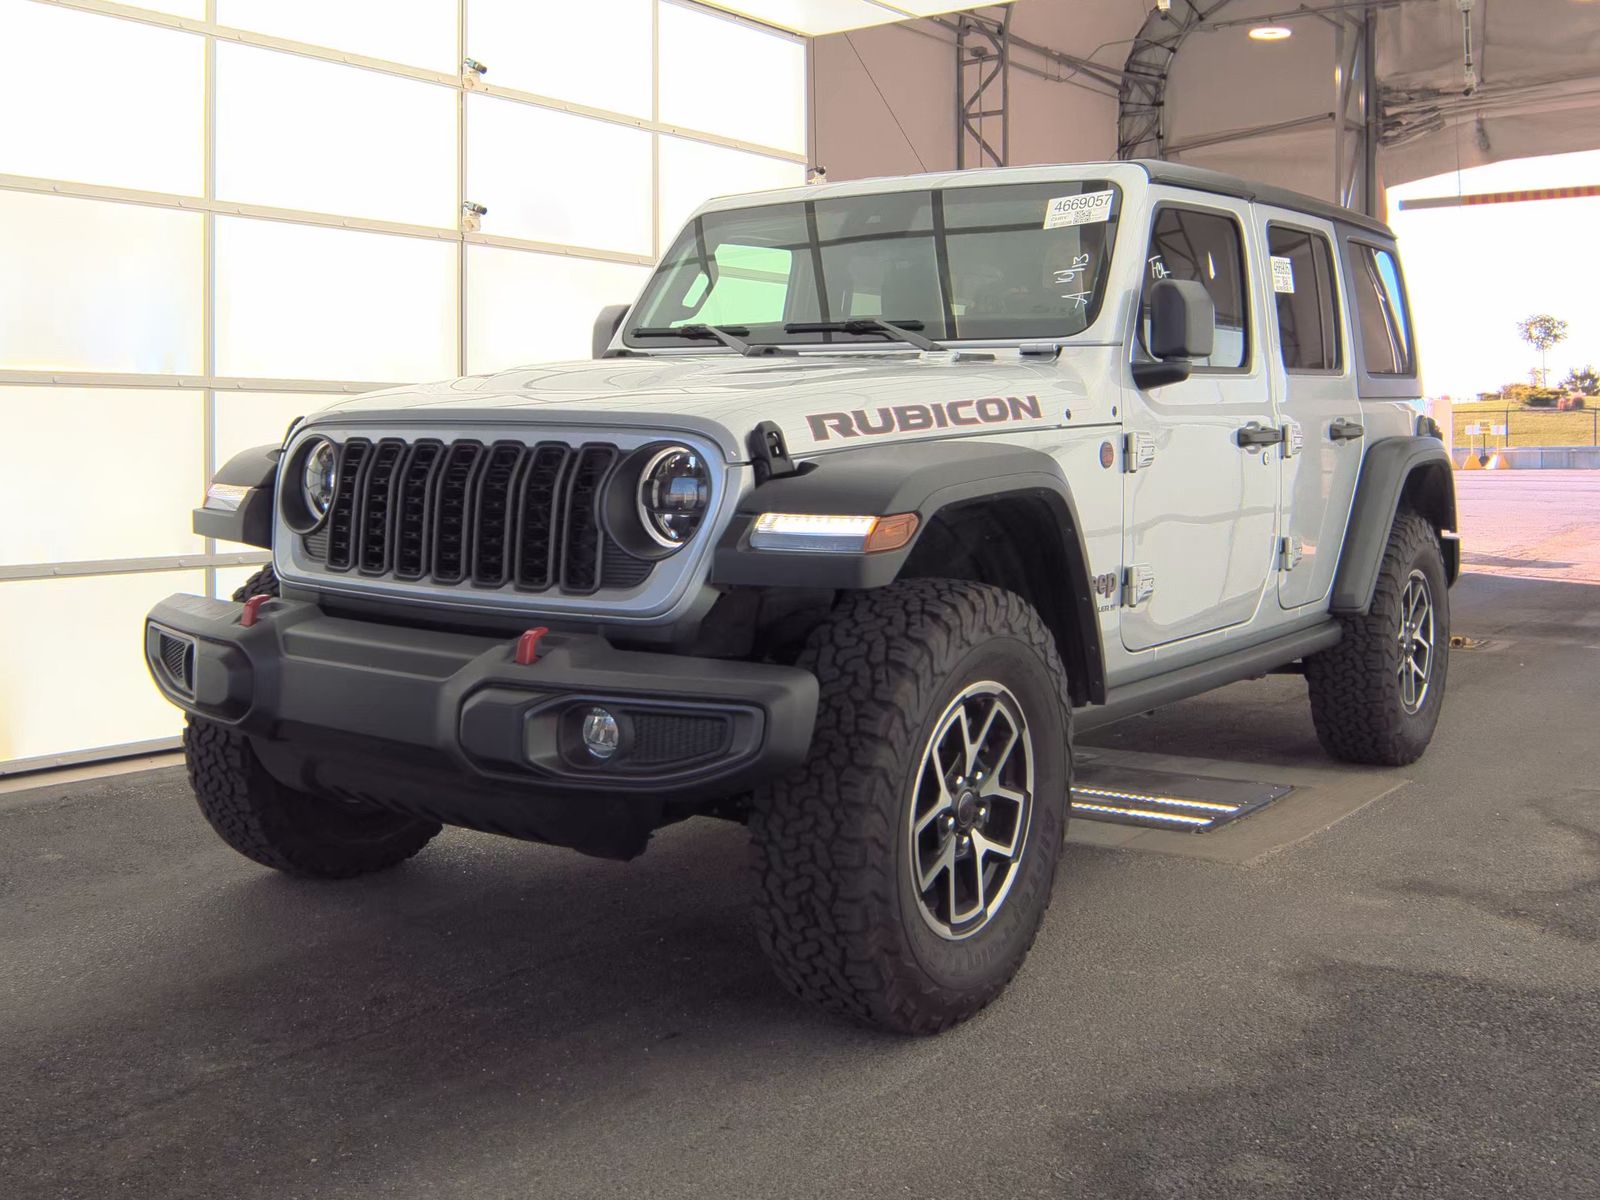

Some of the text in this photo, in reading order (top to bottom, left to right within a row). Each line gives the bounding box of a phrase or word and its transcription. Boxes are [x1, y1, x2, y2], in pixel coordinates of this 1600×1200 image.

[1054, 194, 1113, 212] 4669057
[805, 395, 1043, 441] RUBICON
[1090, 573, 1117, 598] eep
